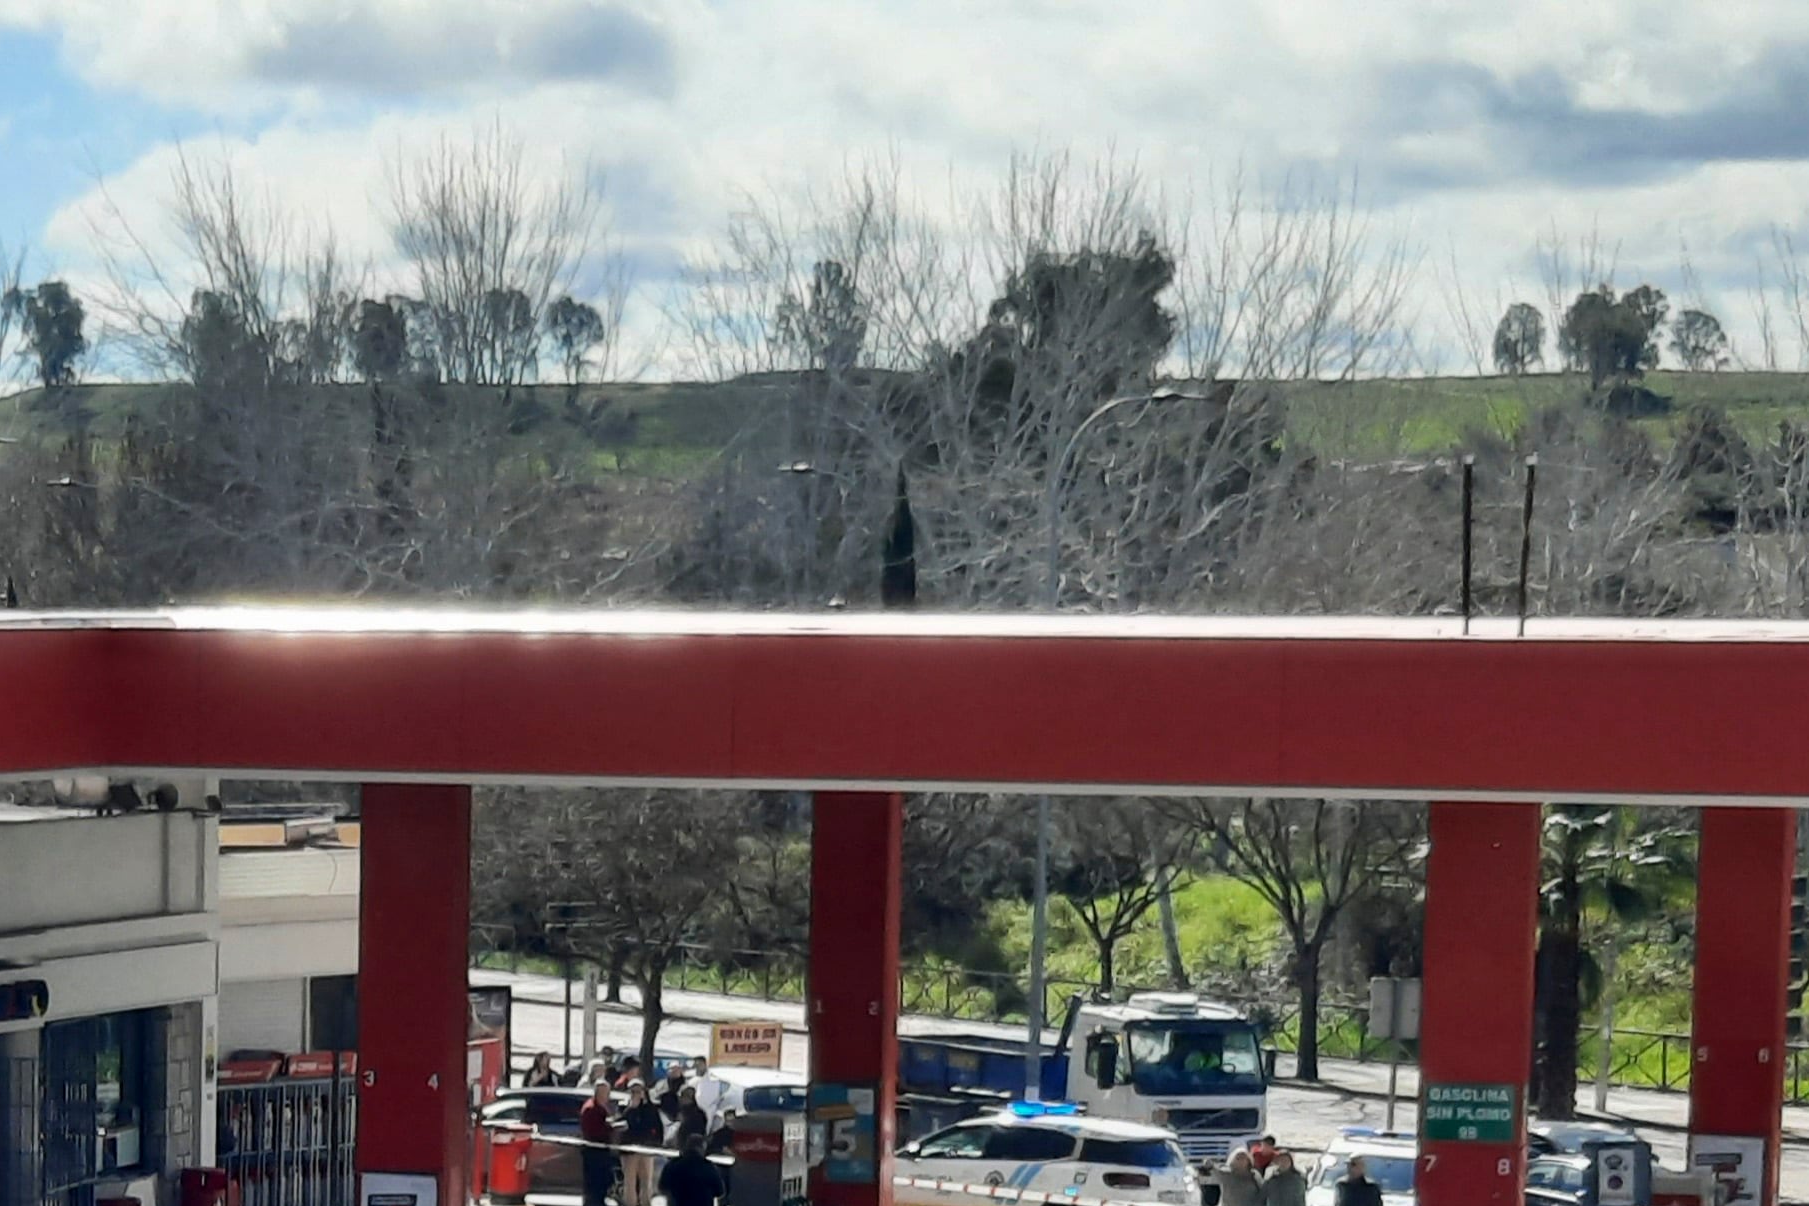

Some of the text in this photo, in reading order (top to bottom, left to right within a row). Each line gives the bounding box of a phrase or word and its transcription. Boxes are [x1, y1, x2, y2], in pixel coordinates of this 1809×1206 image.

[364, 1070, 375, 1087] 3
[427, 1073, 439, 1091] 4
[1426, 1106, 1453, 1120] SIN
[1424, 1155, 1437, 1173] 7
[1497, 1158, 1511, 1176] 8
